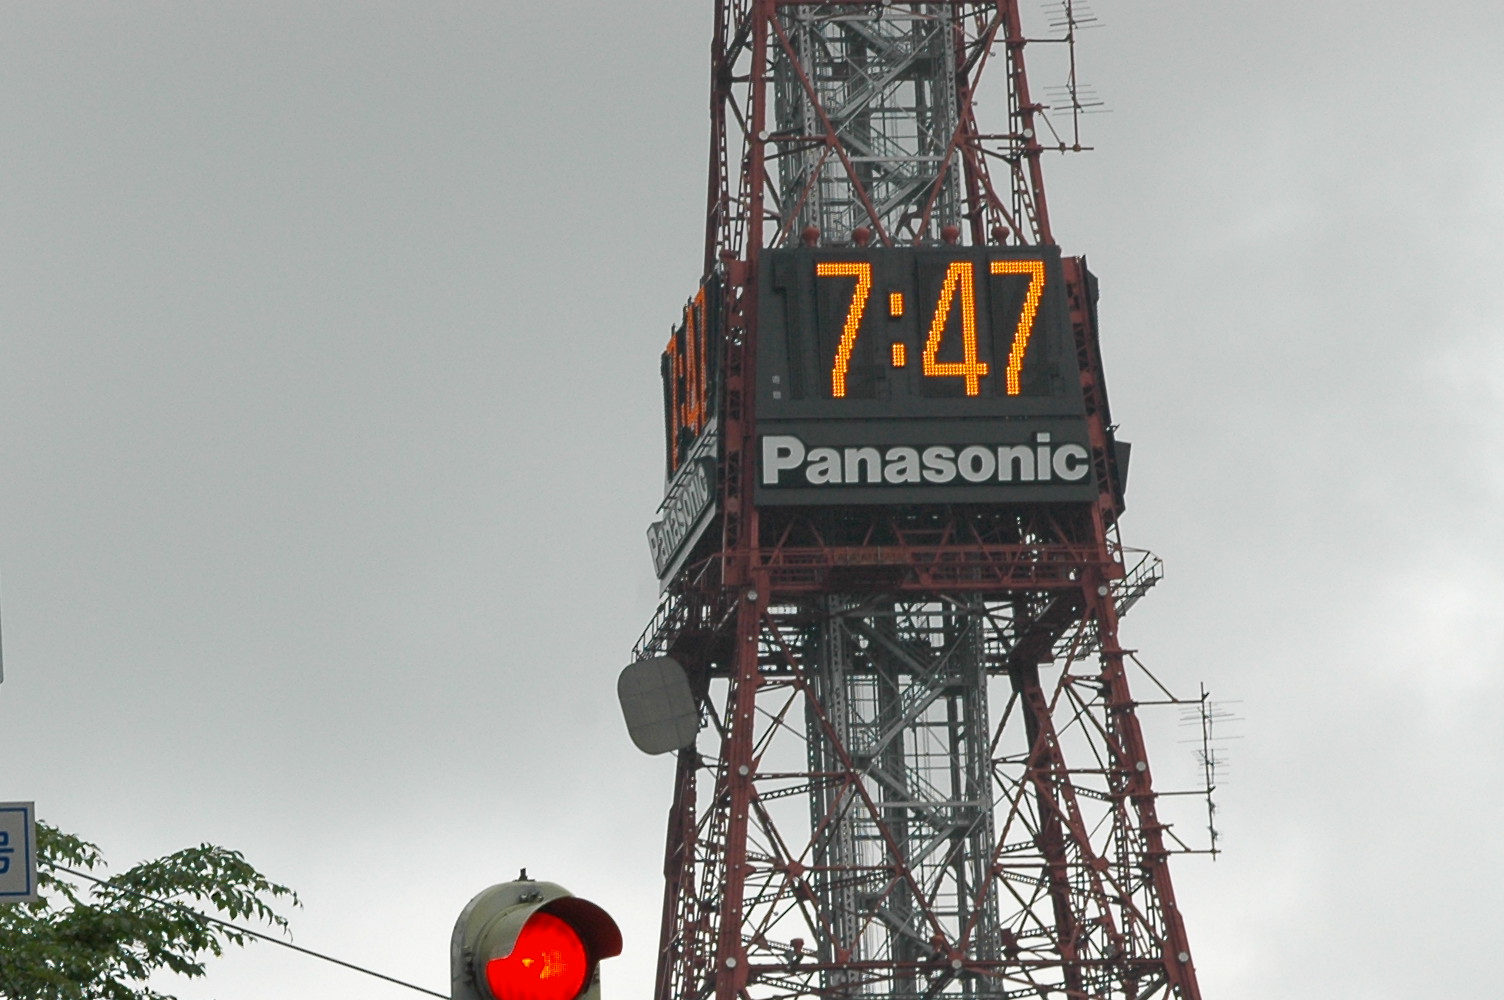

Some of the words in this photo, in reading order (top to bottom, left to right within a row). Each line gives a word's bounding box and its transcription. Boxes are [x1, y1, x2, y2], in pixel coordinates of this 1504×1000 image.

[815, 260, 1046, 398] 7:47
[761, 431, 1090, 486] Panasonic
[648, 461, 709, 573] Panasonic
